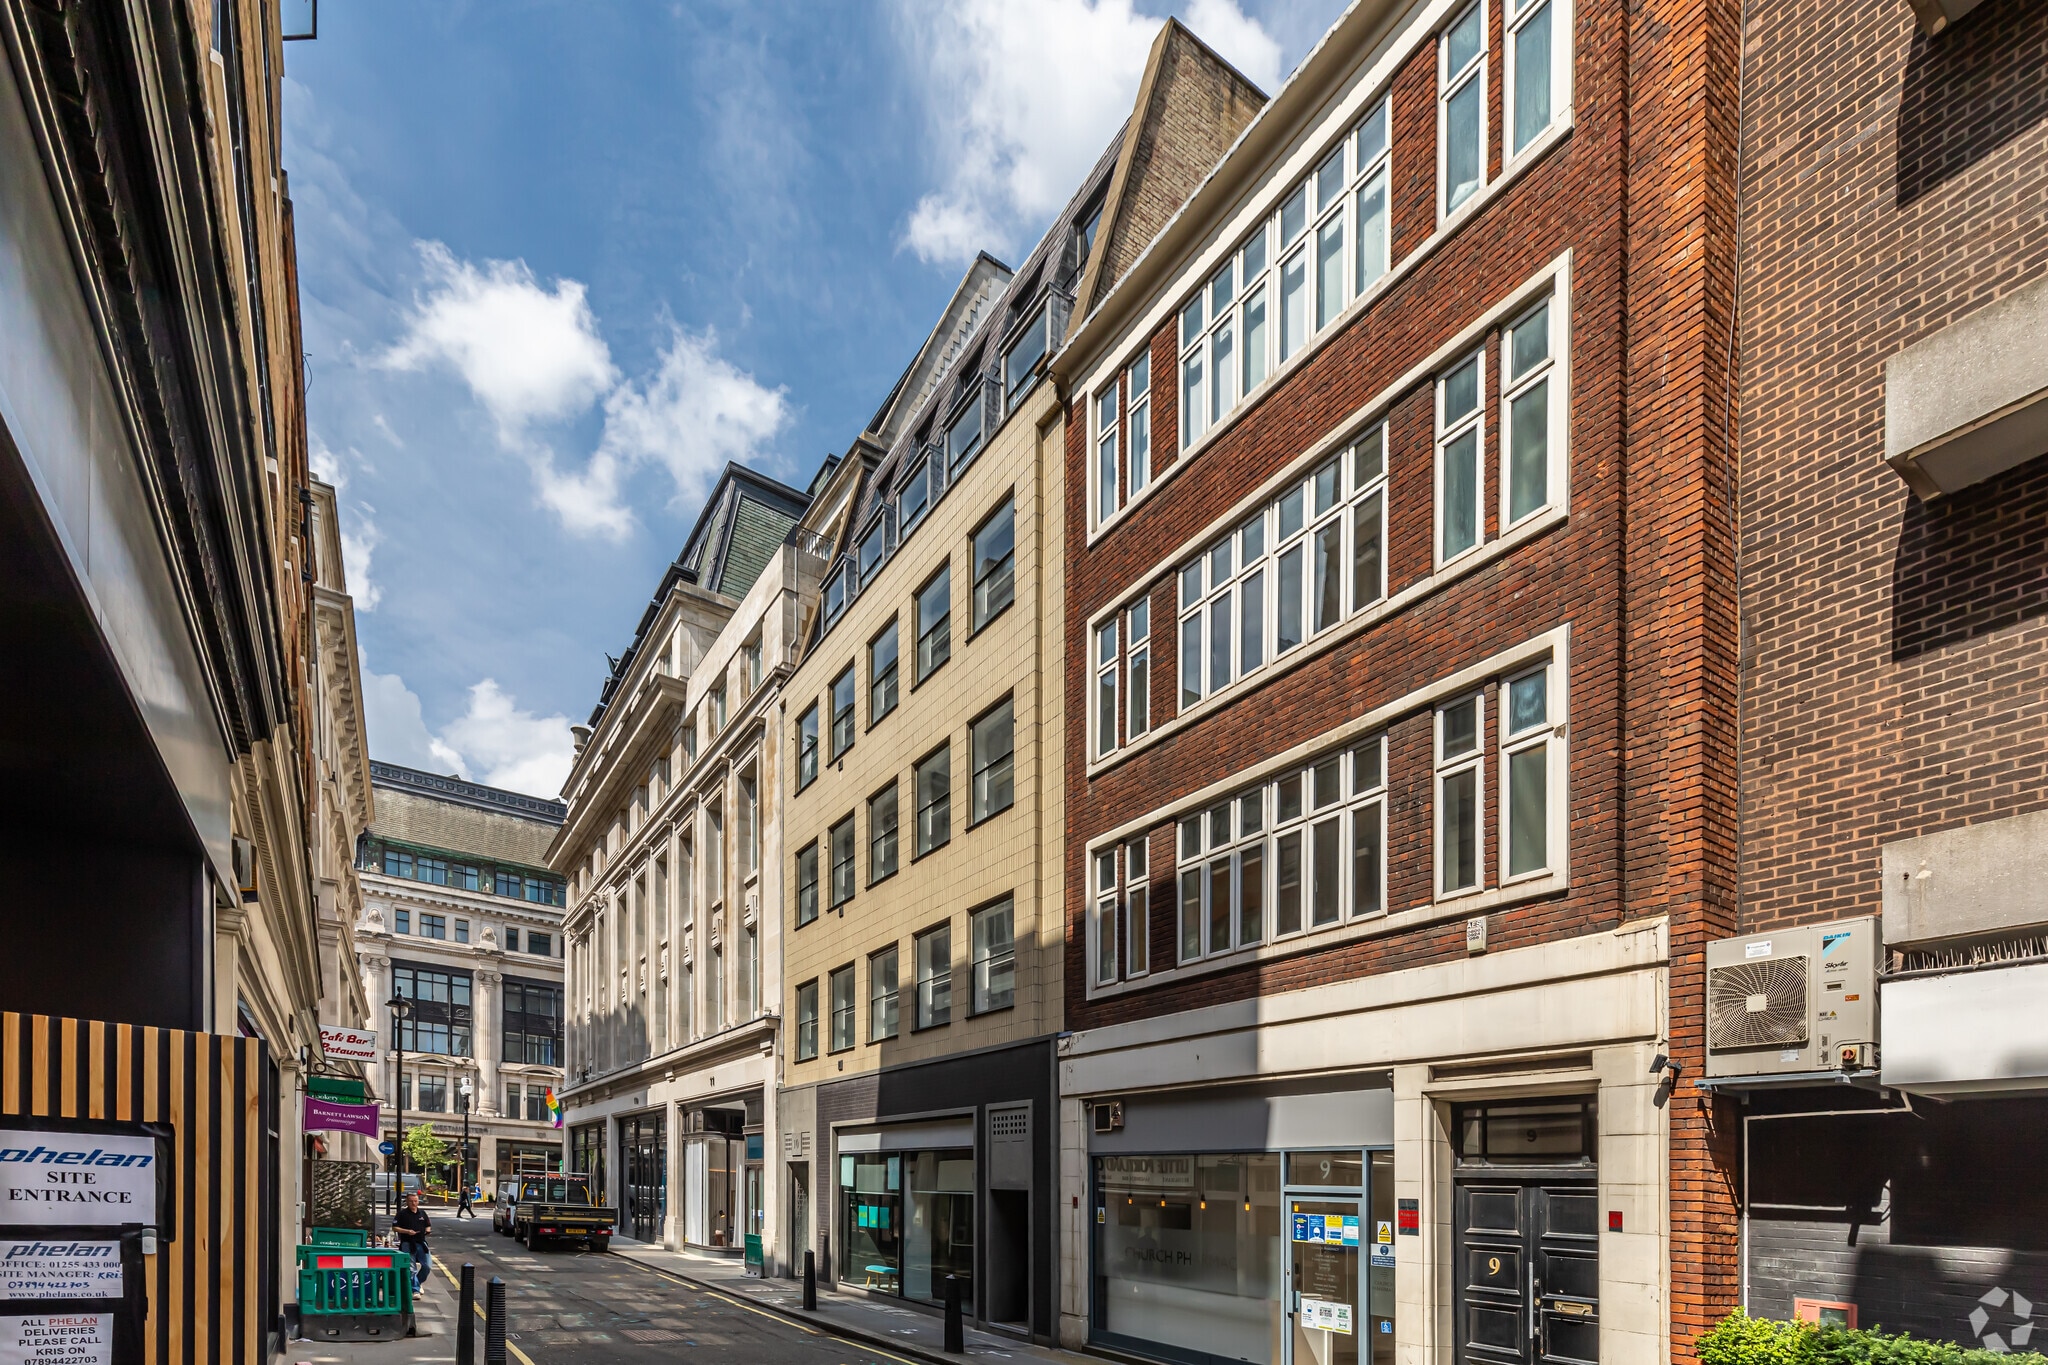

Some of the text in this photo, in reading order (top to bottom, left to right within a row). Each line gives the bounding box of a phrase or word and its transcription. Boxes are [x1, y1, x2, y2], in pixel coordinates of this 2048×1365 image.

[1823, 932, 1851, 940] DAIKIN
[346, 1034, 368, 1045] Bar
[313, 1109, 342, 1117] BARNETT
[0, 1146, 153, 1168] phelan
[1320, 1160, 1330, 1179] 9
[47, 1171, 96, 1184] SITE
[8, 1188, 132, 1203] ENTRANCE
[5, 1242, 112, 1259] phelan
[1125, 1246, 1173, 1264] CHURCH
[1488, 1257, 1500, 1275] 9
[21, 1317, 98, 1327] ALL PHELAN
[24, 1327, 96, 1336] DELIVERIES
[19, 1336, 102, 1346] PLEASE CALL
[36, 1347, 65, 1356] KRIS
[24, 1356, 97, 1365] 07894422703
